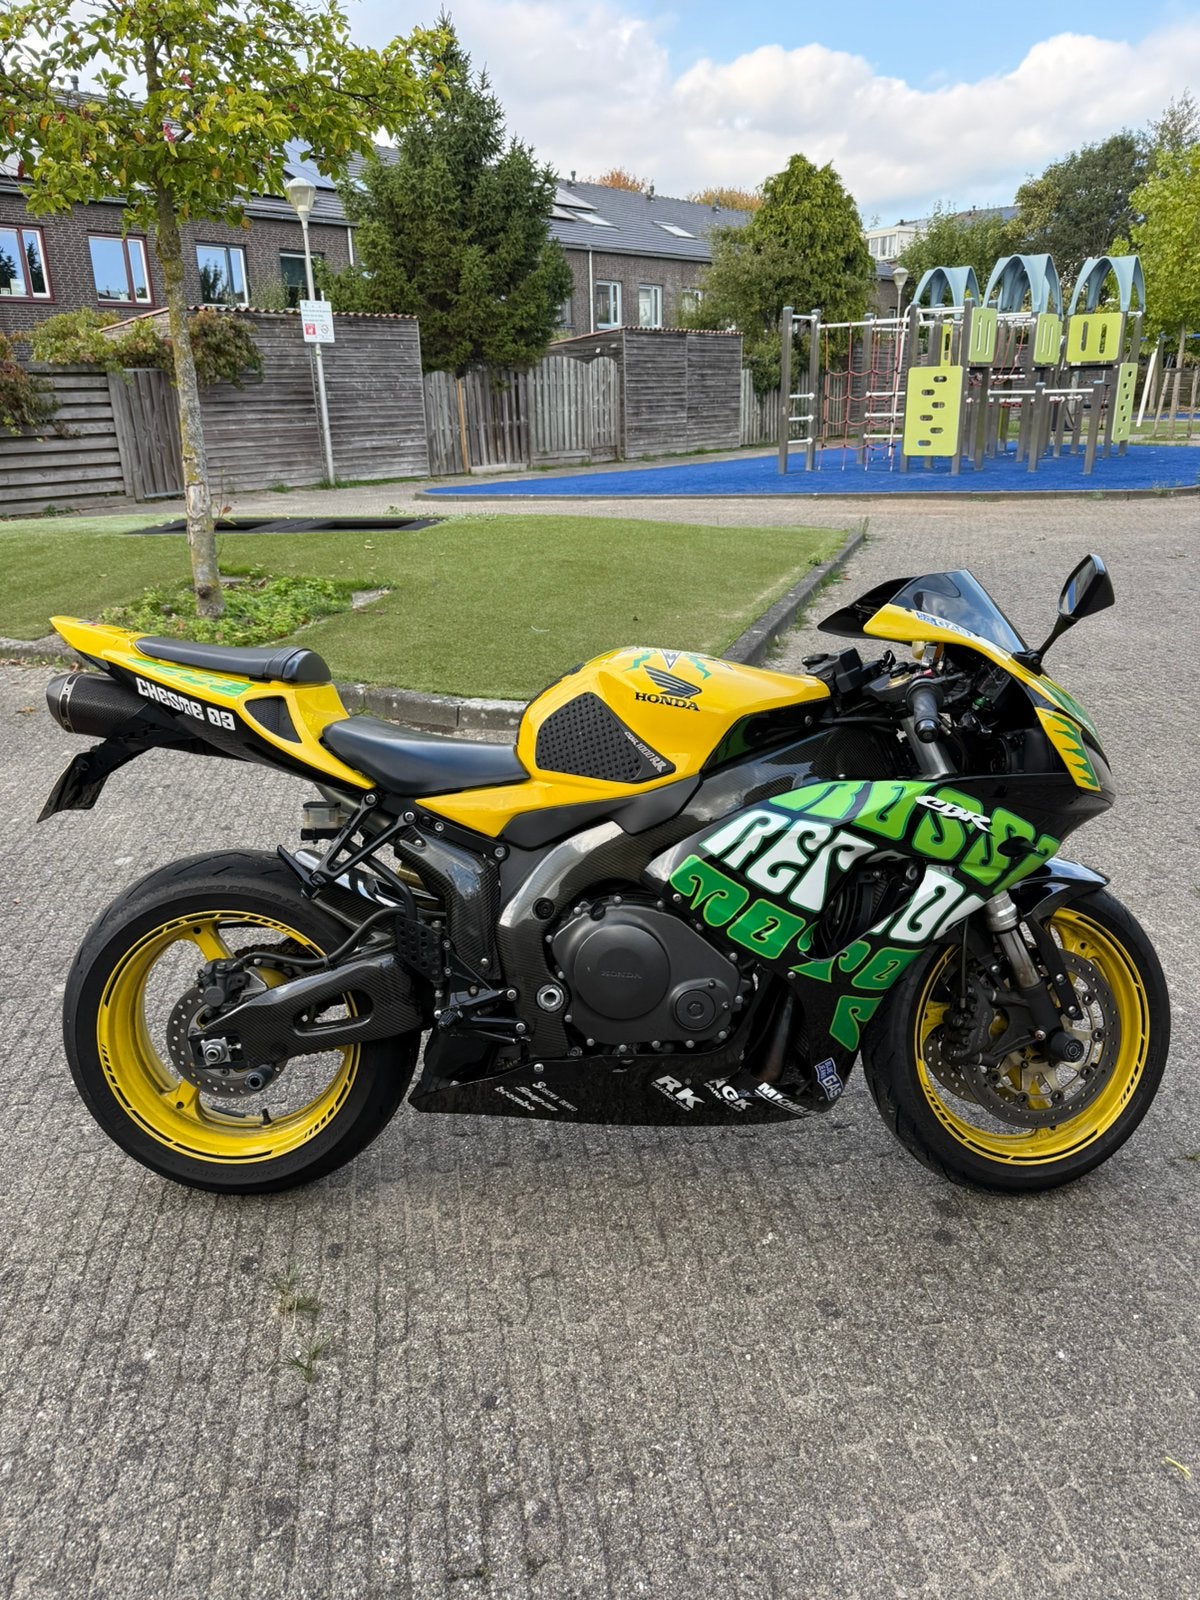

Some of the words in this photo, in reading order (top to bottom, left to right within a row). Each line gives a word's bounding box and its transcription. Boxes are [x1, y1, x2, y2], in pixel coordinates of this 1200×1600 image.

[635, 692, 701, 712] HONDA
[206, 706, 236, 731] 03
[915, 795, 991, 833] CBR
[601, 970, 642, 979] HONDA
[494, 1086, 536, 1111] brembo
[655, 1075, 706, 1109] RK
[708, 1079, 753, 1110] NGK
[822, 1074, 842, 1099] GAS
